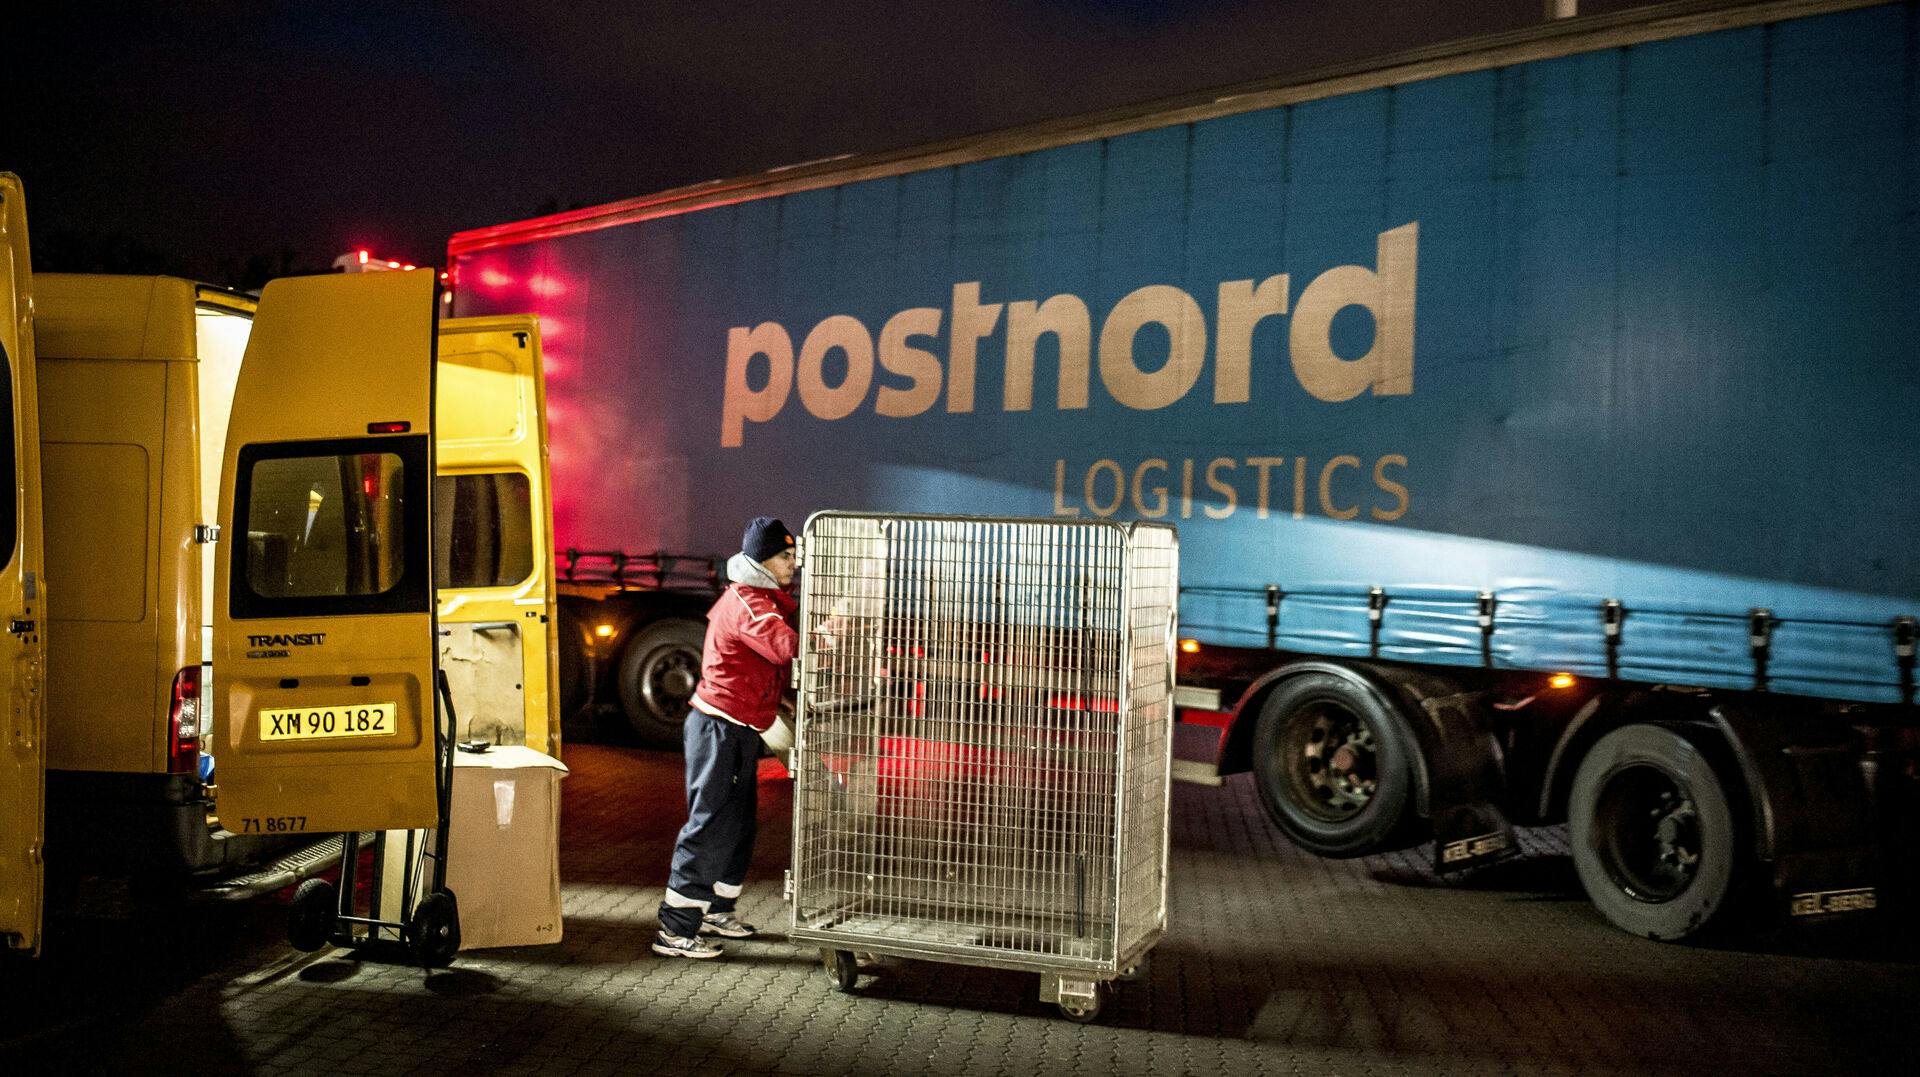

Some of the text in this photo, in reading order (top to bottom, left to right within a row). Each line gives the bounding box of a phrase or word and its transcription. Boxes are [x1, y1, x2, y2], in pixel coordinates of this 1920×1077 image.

[720, 221, 1419, 447] postnord
[1053, 454, 1411, 522] LOGISTICS
[247, 633, 326, 647] TRANSIT
[270, 709, 385, 735] XM 90 182
[242, 816, 307, 832] 71 8677
